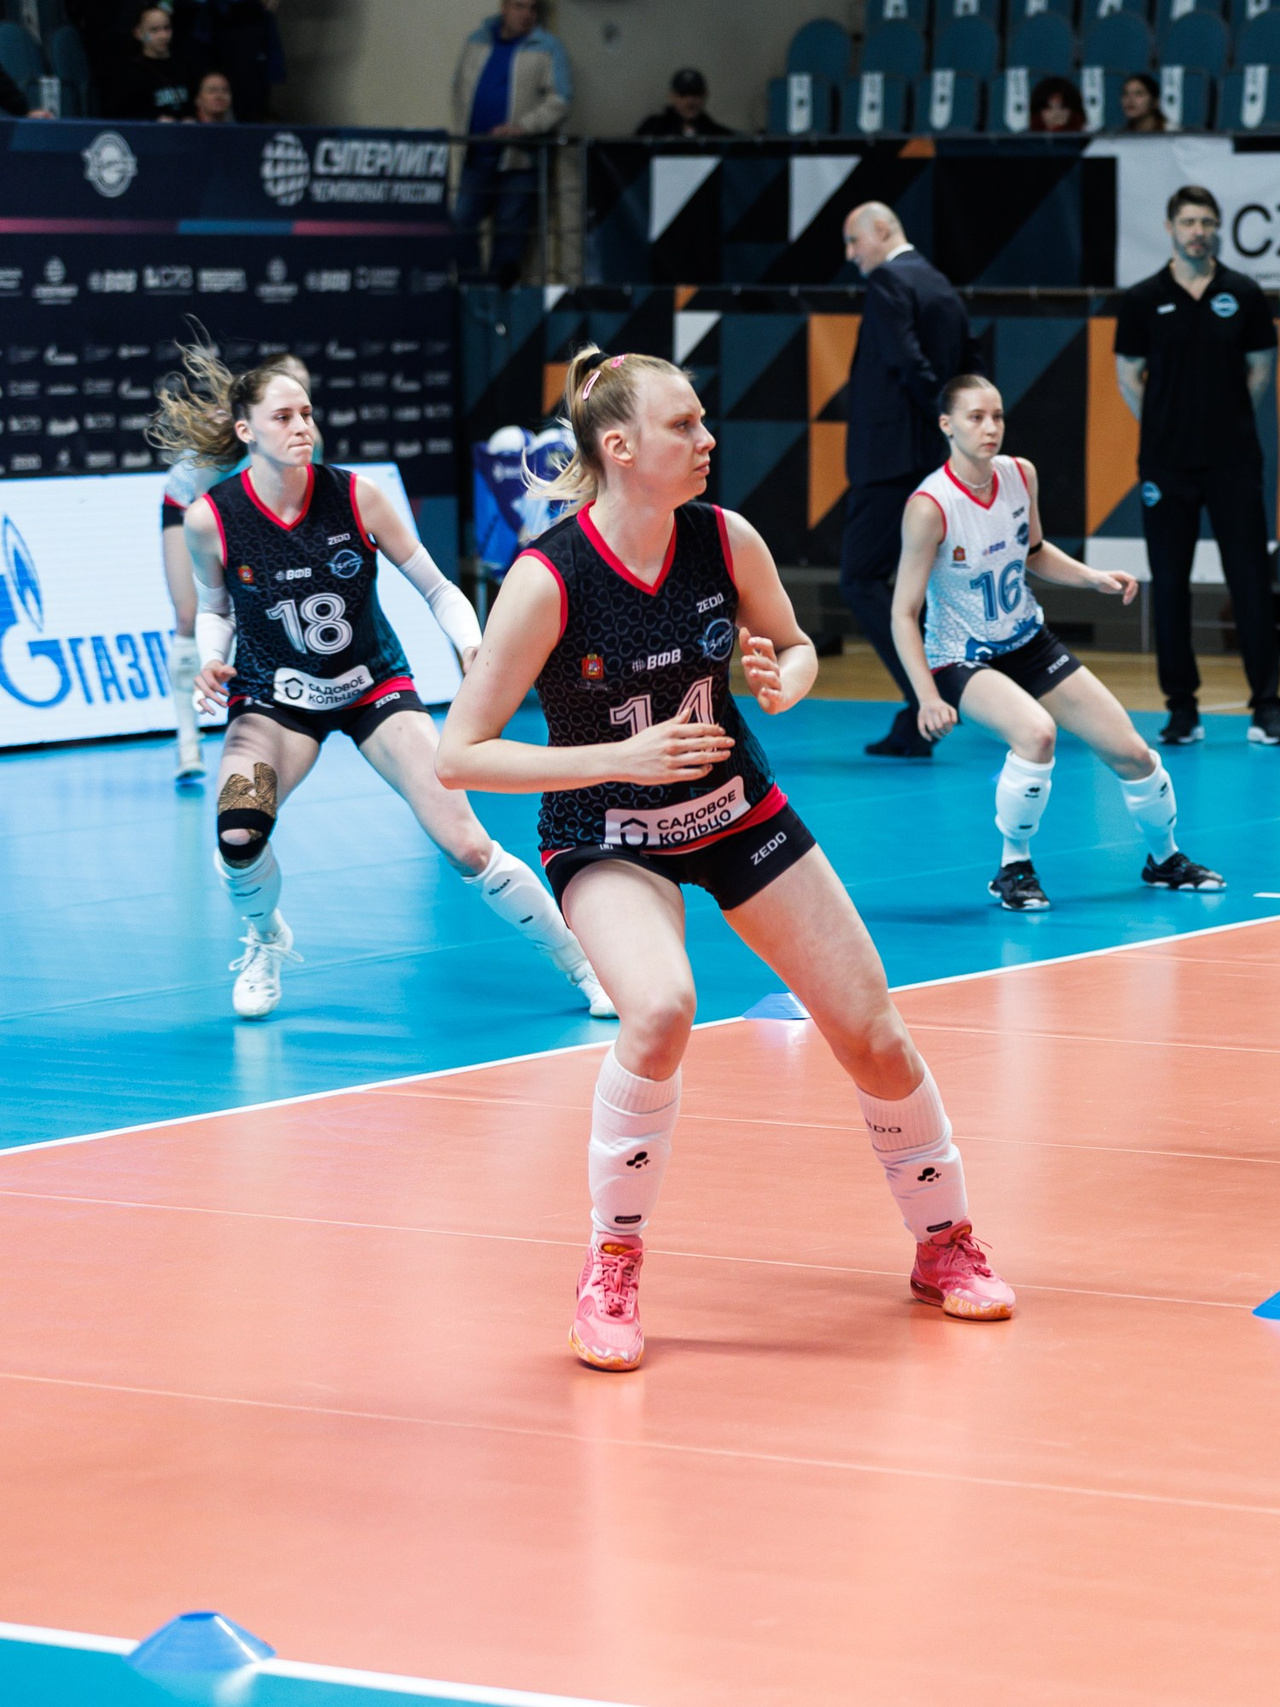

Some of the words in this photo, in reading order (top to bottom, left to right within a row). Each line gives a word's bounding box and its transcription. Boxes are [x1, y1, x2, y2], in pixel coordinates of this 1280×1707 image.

[313, 138, 448, 177] СУПЕРЛИГА
[327, 533, 351, 546] ZEDO
[286, 567, 312, 580] ВФВ
[969, 559, 1024, 622] 16
[696, 592, 725, 614] ZEDO
[265, 593, 353, 655] 18
[67, 630, 176, 705] ГАЗП
[647, 648, 682, 671] ВФВ
[308, 675, 365, 696] САДОВОЕ
[656, 789, 737, 830] САДОВОЕ
[658, 809, 732, 845] КОЛЬЦО
[750, 830, 788, 866] ZEDO
